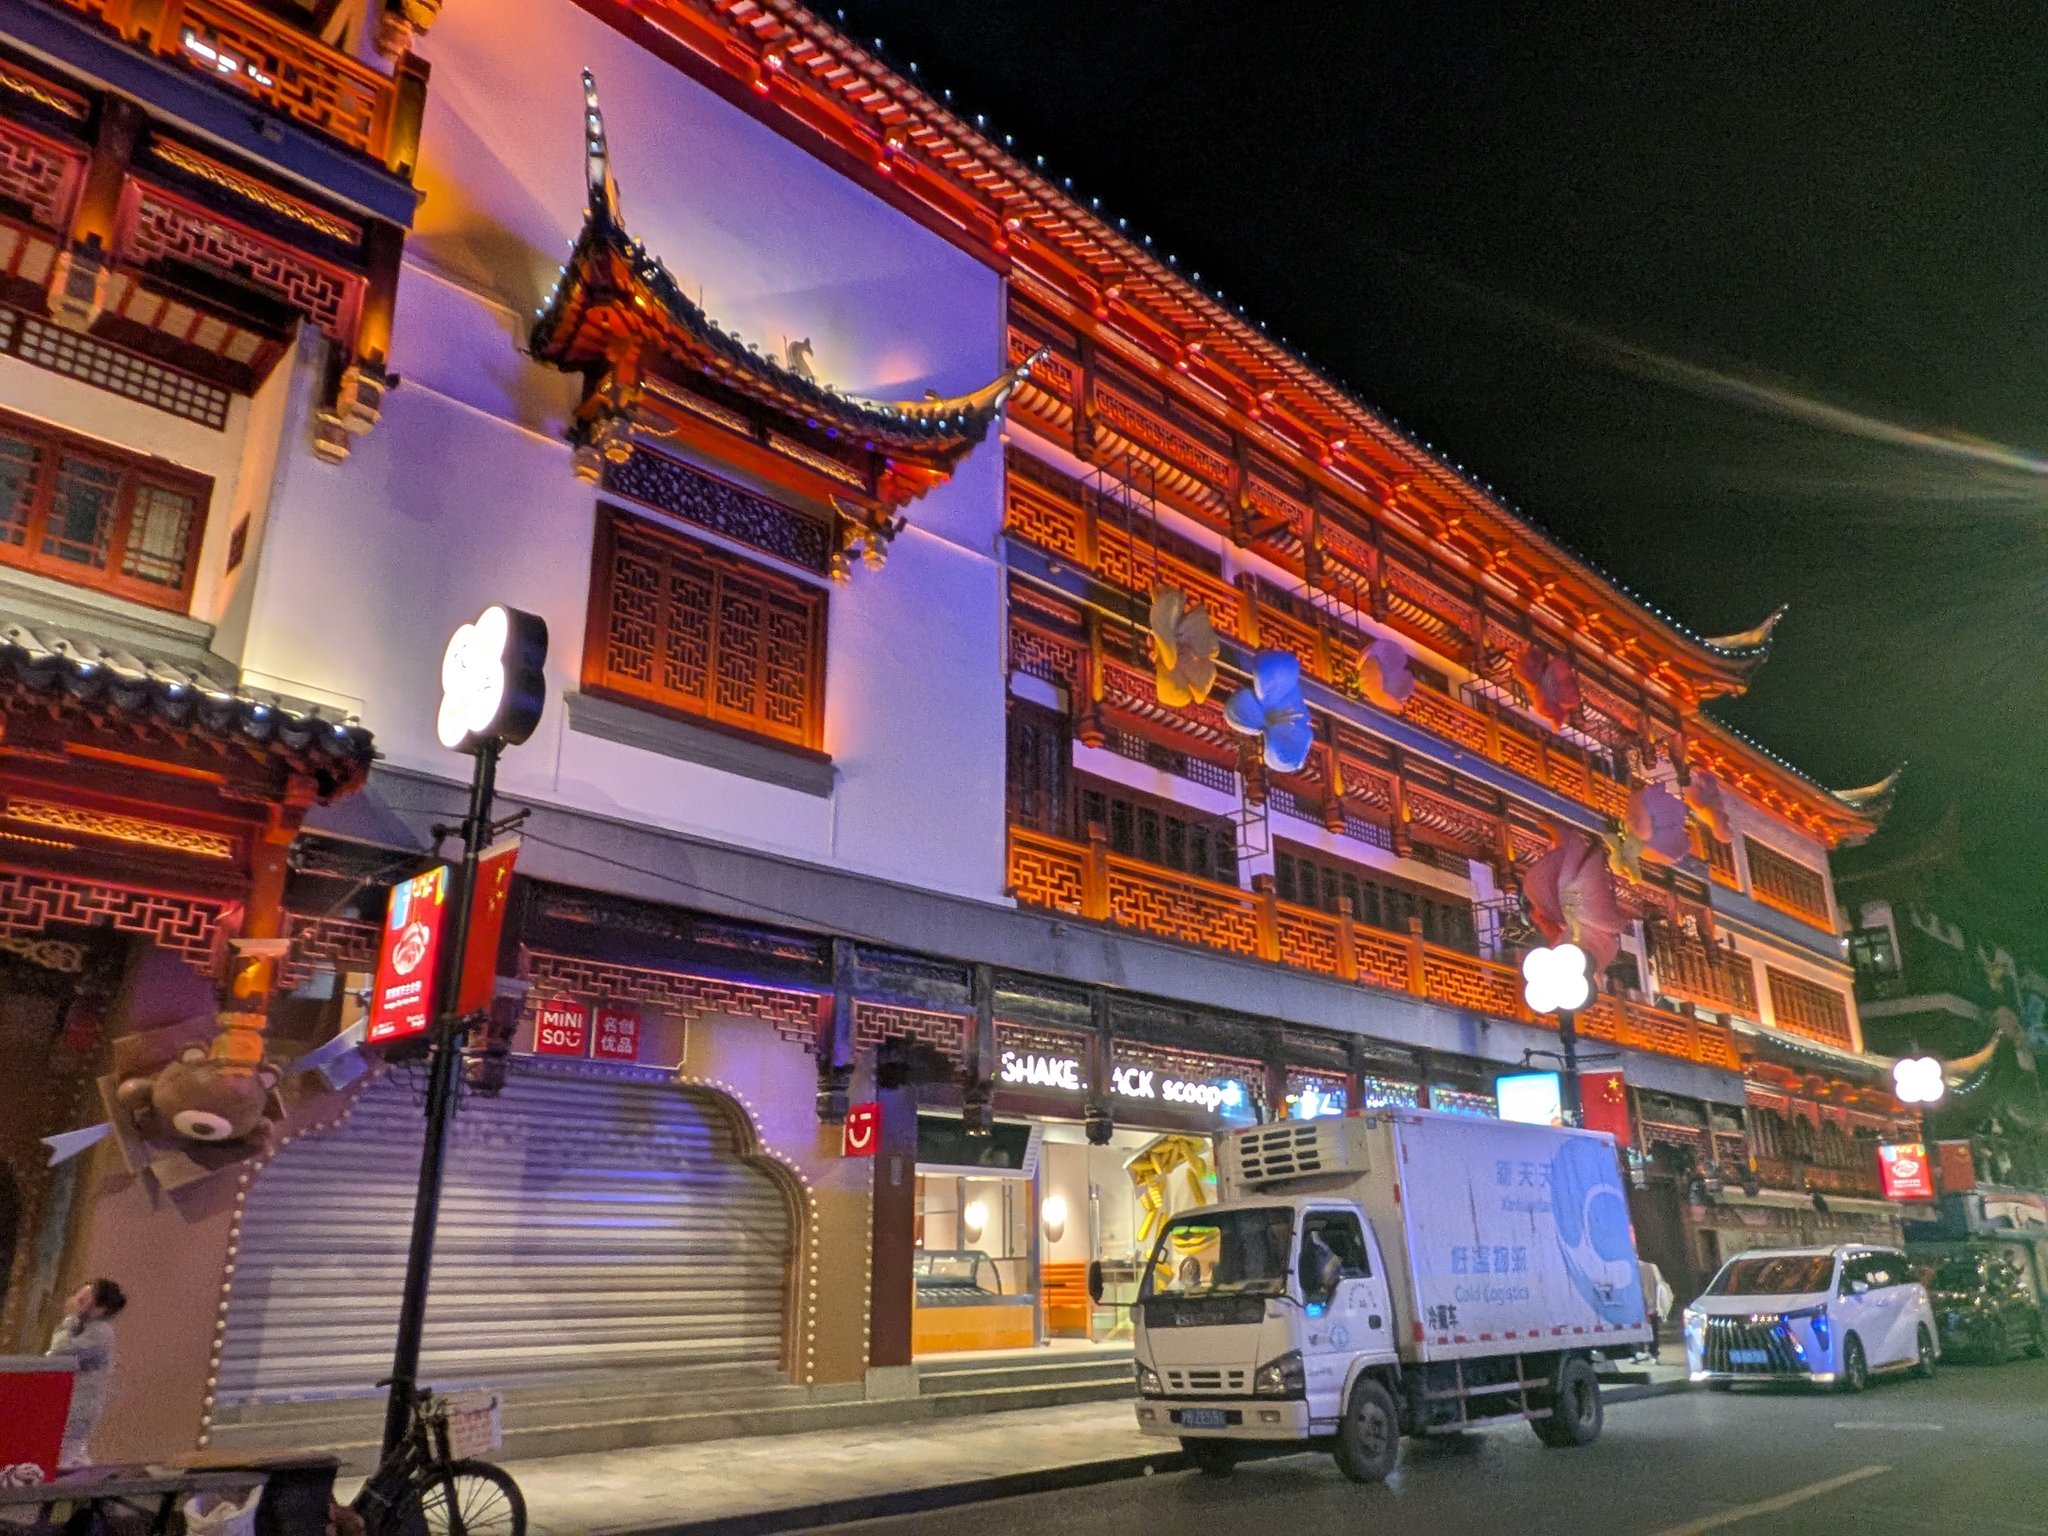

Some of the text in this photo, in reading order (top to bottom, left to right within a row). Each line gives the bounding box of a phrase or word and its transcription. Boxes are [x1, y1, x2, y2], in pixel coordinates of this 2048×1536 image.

[543, 1011, 583, 1028] MINI
[604, 1016, 635, 1035] 名创
[601, 1033, 633, 1055] 优品
[1000, 1051, 1080, 1090] SHAKE
